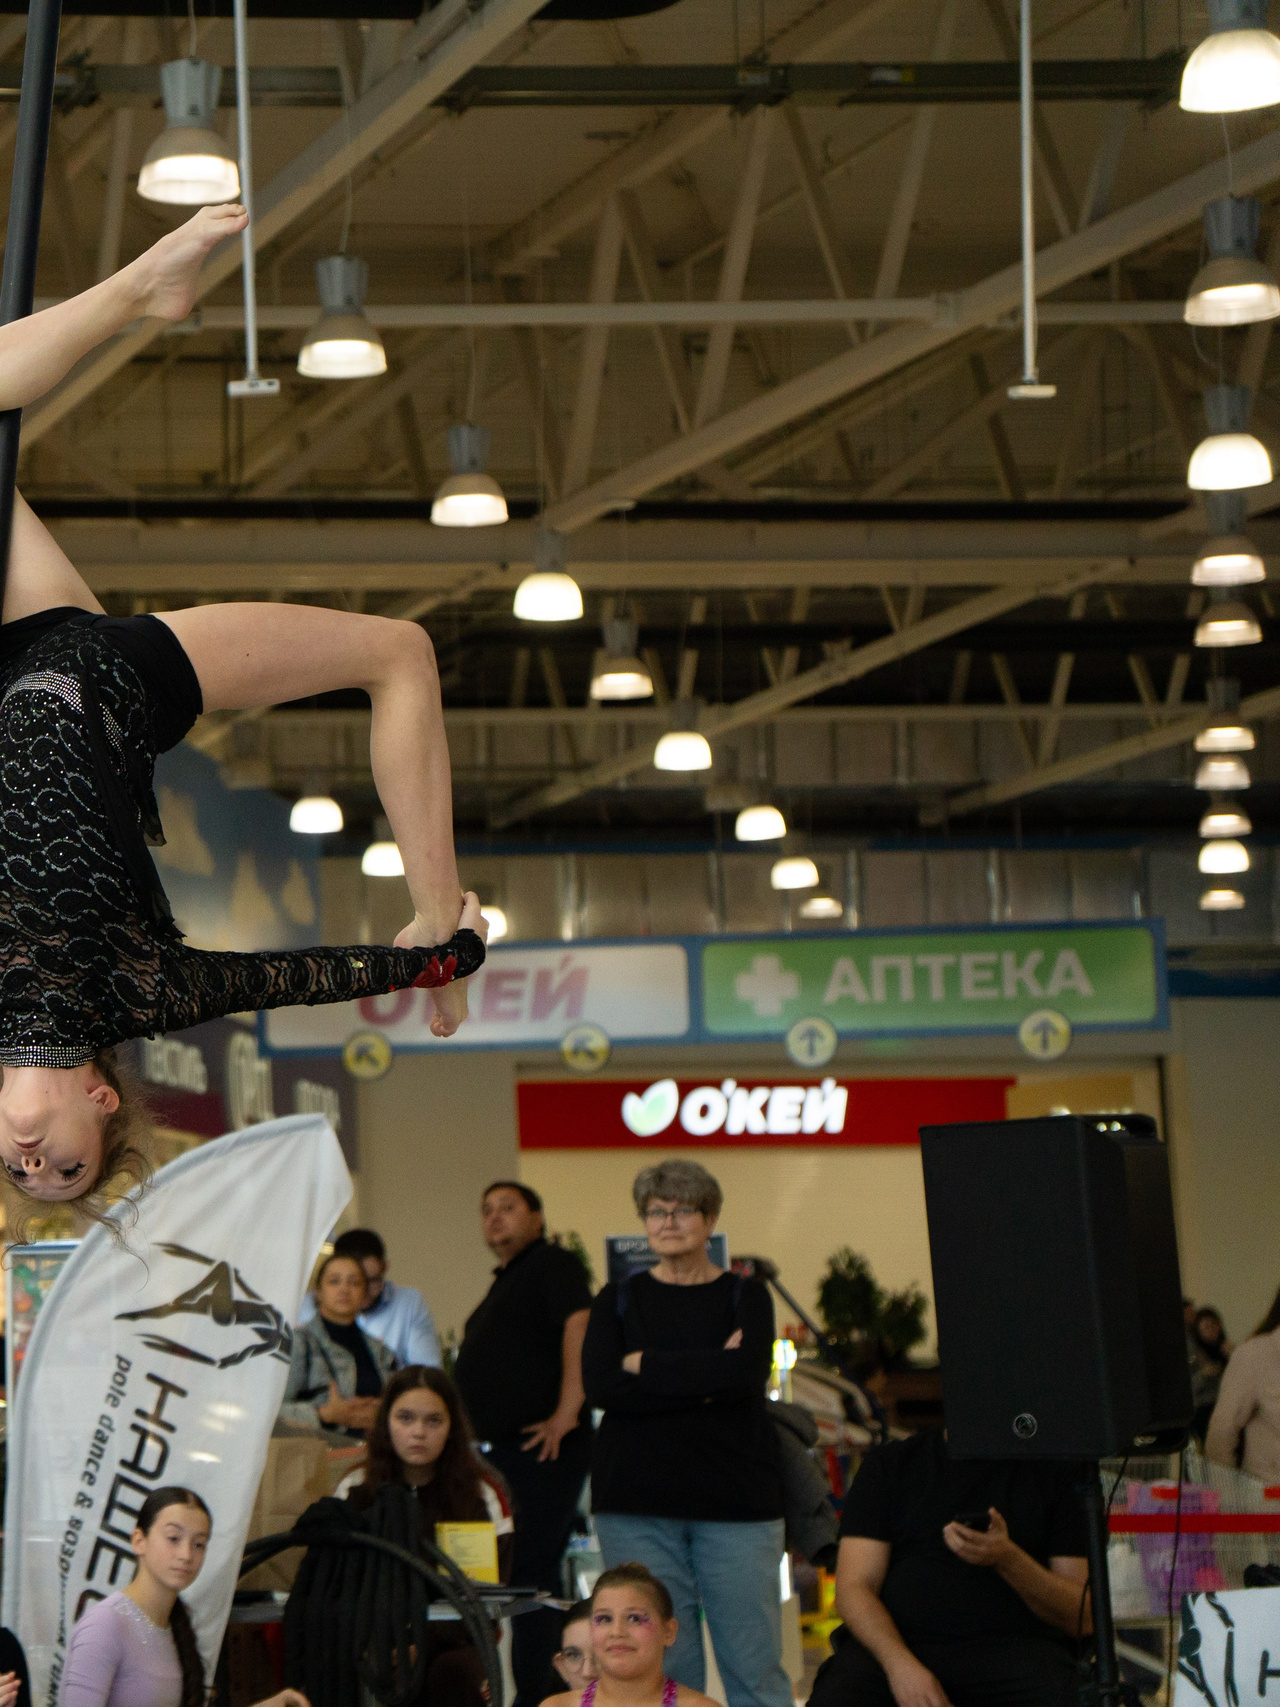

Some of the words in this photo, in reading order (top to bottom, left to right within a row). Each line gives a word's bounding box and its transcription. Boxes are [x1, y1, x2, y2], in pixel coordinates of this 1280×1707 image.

[358, 953, 589, 1026] ОЕЙ
[824, 948, 1095, 1003] АПТЕКА
[104, 1354, 132, 1408] pole
[81, 1414, 116, 1486] dance
[74, 1491, 94, 1511] &
